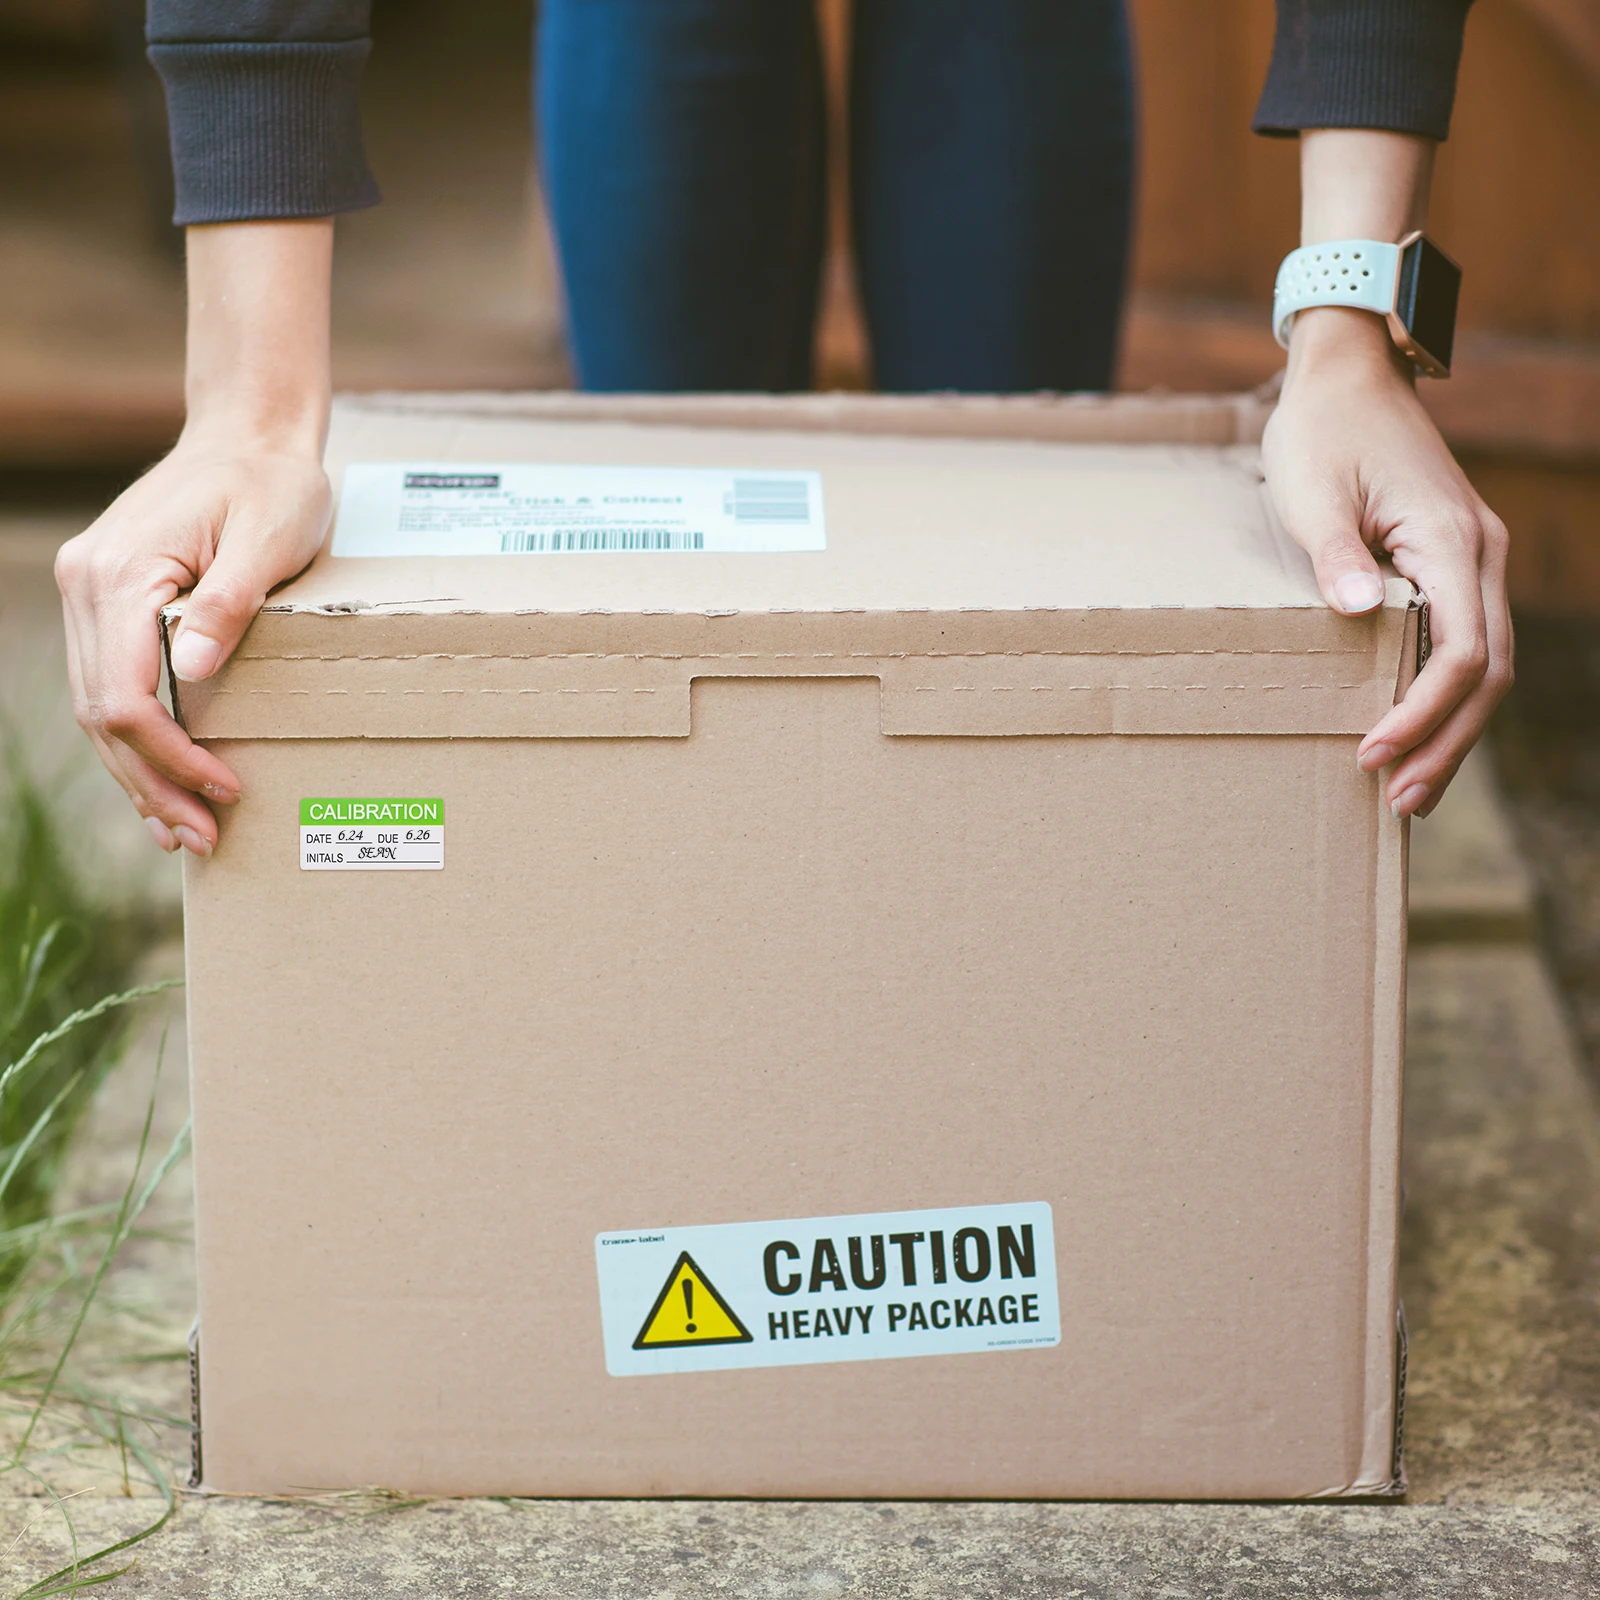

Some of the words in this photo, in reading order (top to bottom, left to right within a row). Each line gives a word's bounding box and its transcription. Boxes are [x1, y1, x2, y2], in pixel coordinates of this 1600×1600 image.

[508, 495, 565, 506] Click
[602, 495, 683, 505] Collect
[309, 803, 437, 820] CALIBRATION
[306, 833, 332, 844] DATE
[338, 829, 364, 841] 6.24
[377, 833, 399, 844] DUE
[405, 829, 431, 841] 6.26
[306, 853, 344, 863] INITALS
[357, 846, 397, 860] SEAN
[762, 1223, 1037, 1296] CAUTION
[767, 1305, 875, 1341] HEAVY
[888, 1293, 1041, 1333] PACKAGE
